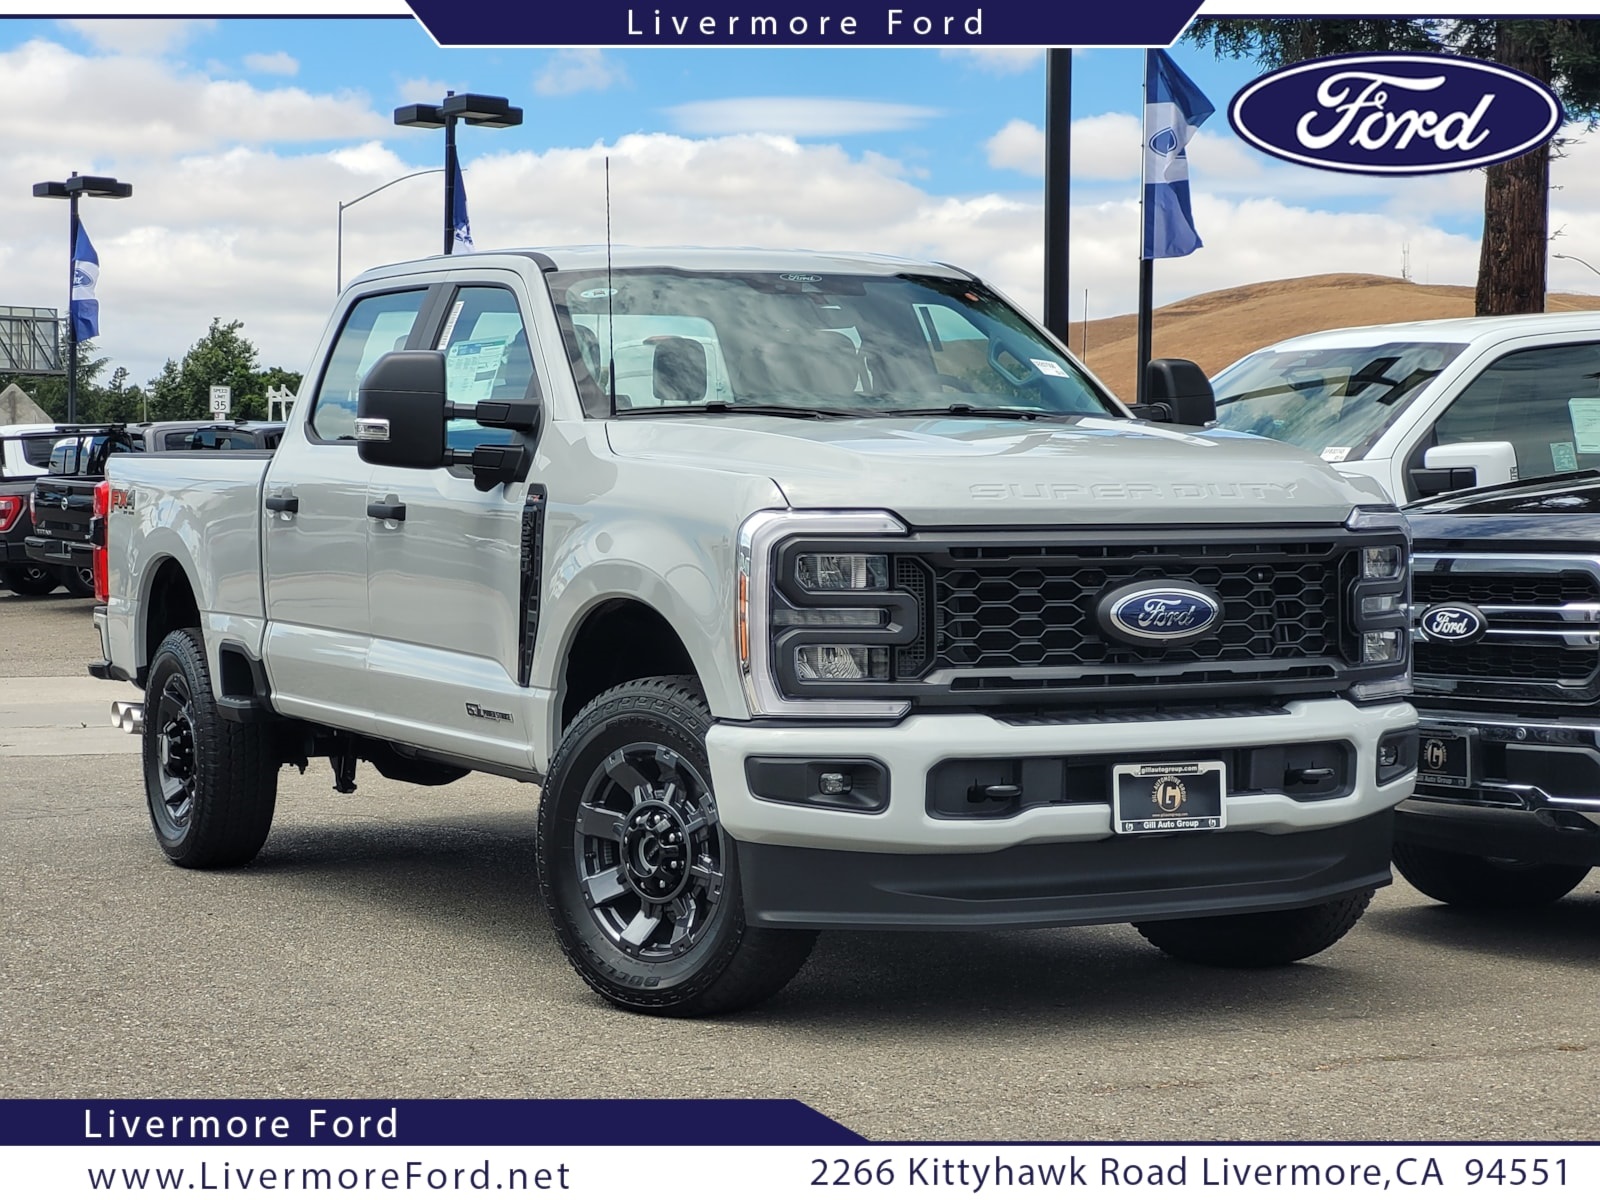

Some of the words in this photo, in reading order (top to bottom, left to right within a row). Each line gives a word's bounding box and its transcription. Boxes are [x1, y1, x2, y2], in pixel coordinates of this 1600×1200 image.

[213, 400, 227, 411] 35
[968, 483, 1164, 500] SUPER
[1169, 482, 1298, 500] DUTY
[111, 488, 136, 513] FX4
[36, 528, 52, 536] TITAN
[1138, 599, 1196, 627] Ford
[1432, 611, 1468, 634] Ford
[1140, 765, 1198, 775] gillautogroup.com
[1153, 775, 1182, 790] AUTOMOTIVE
[1179, 783, 1187, 802] GROUP
[1143, 821, 1156, 829] Gill
[1157, 820, 1175, 829] Auto
[1176, 820, 1199, 829] Group
